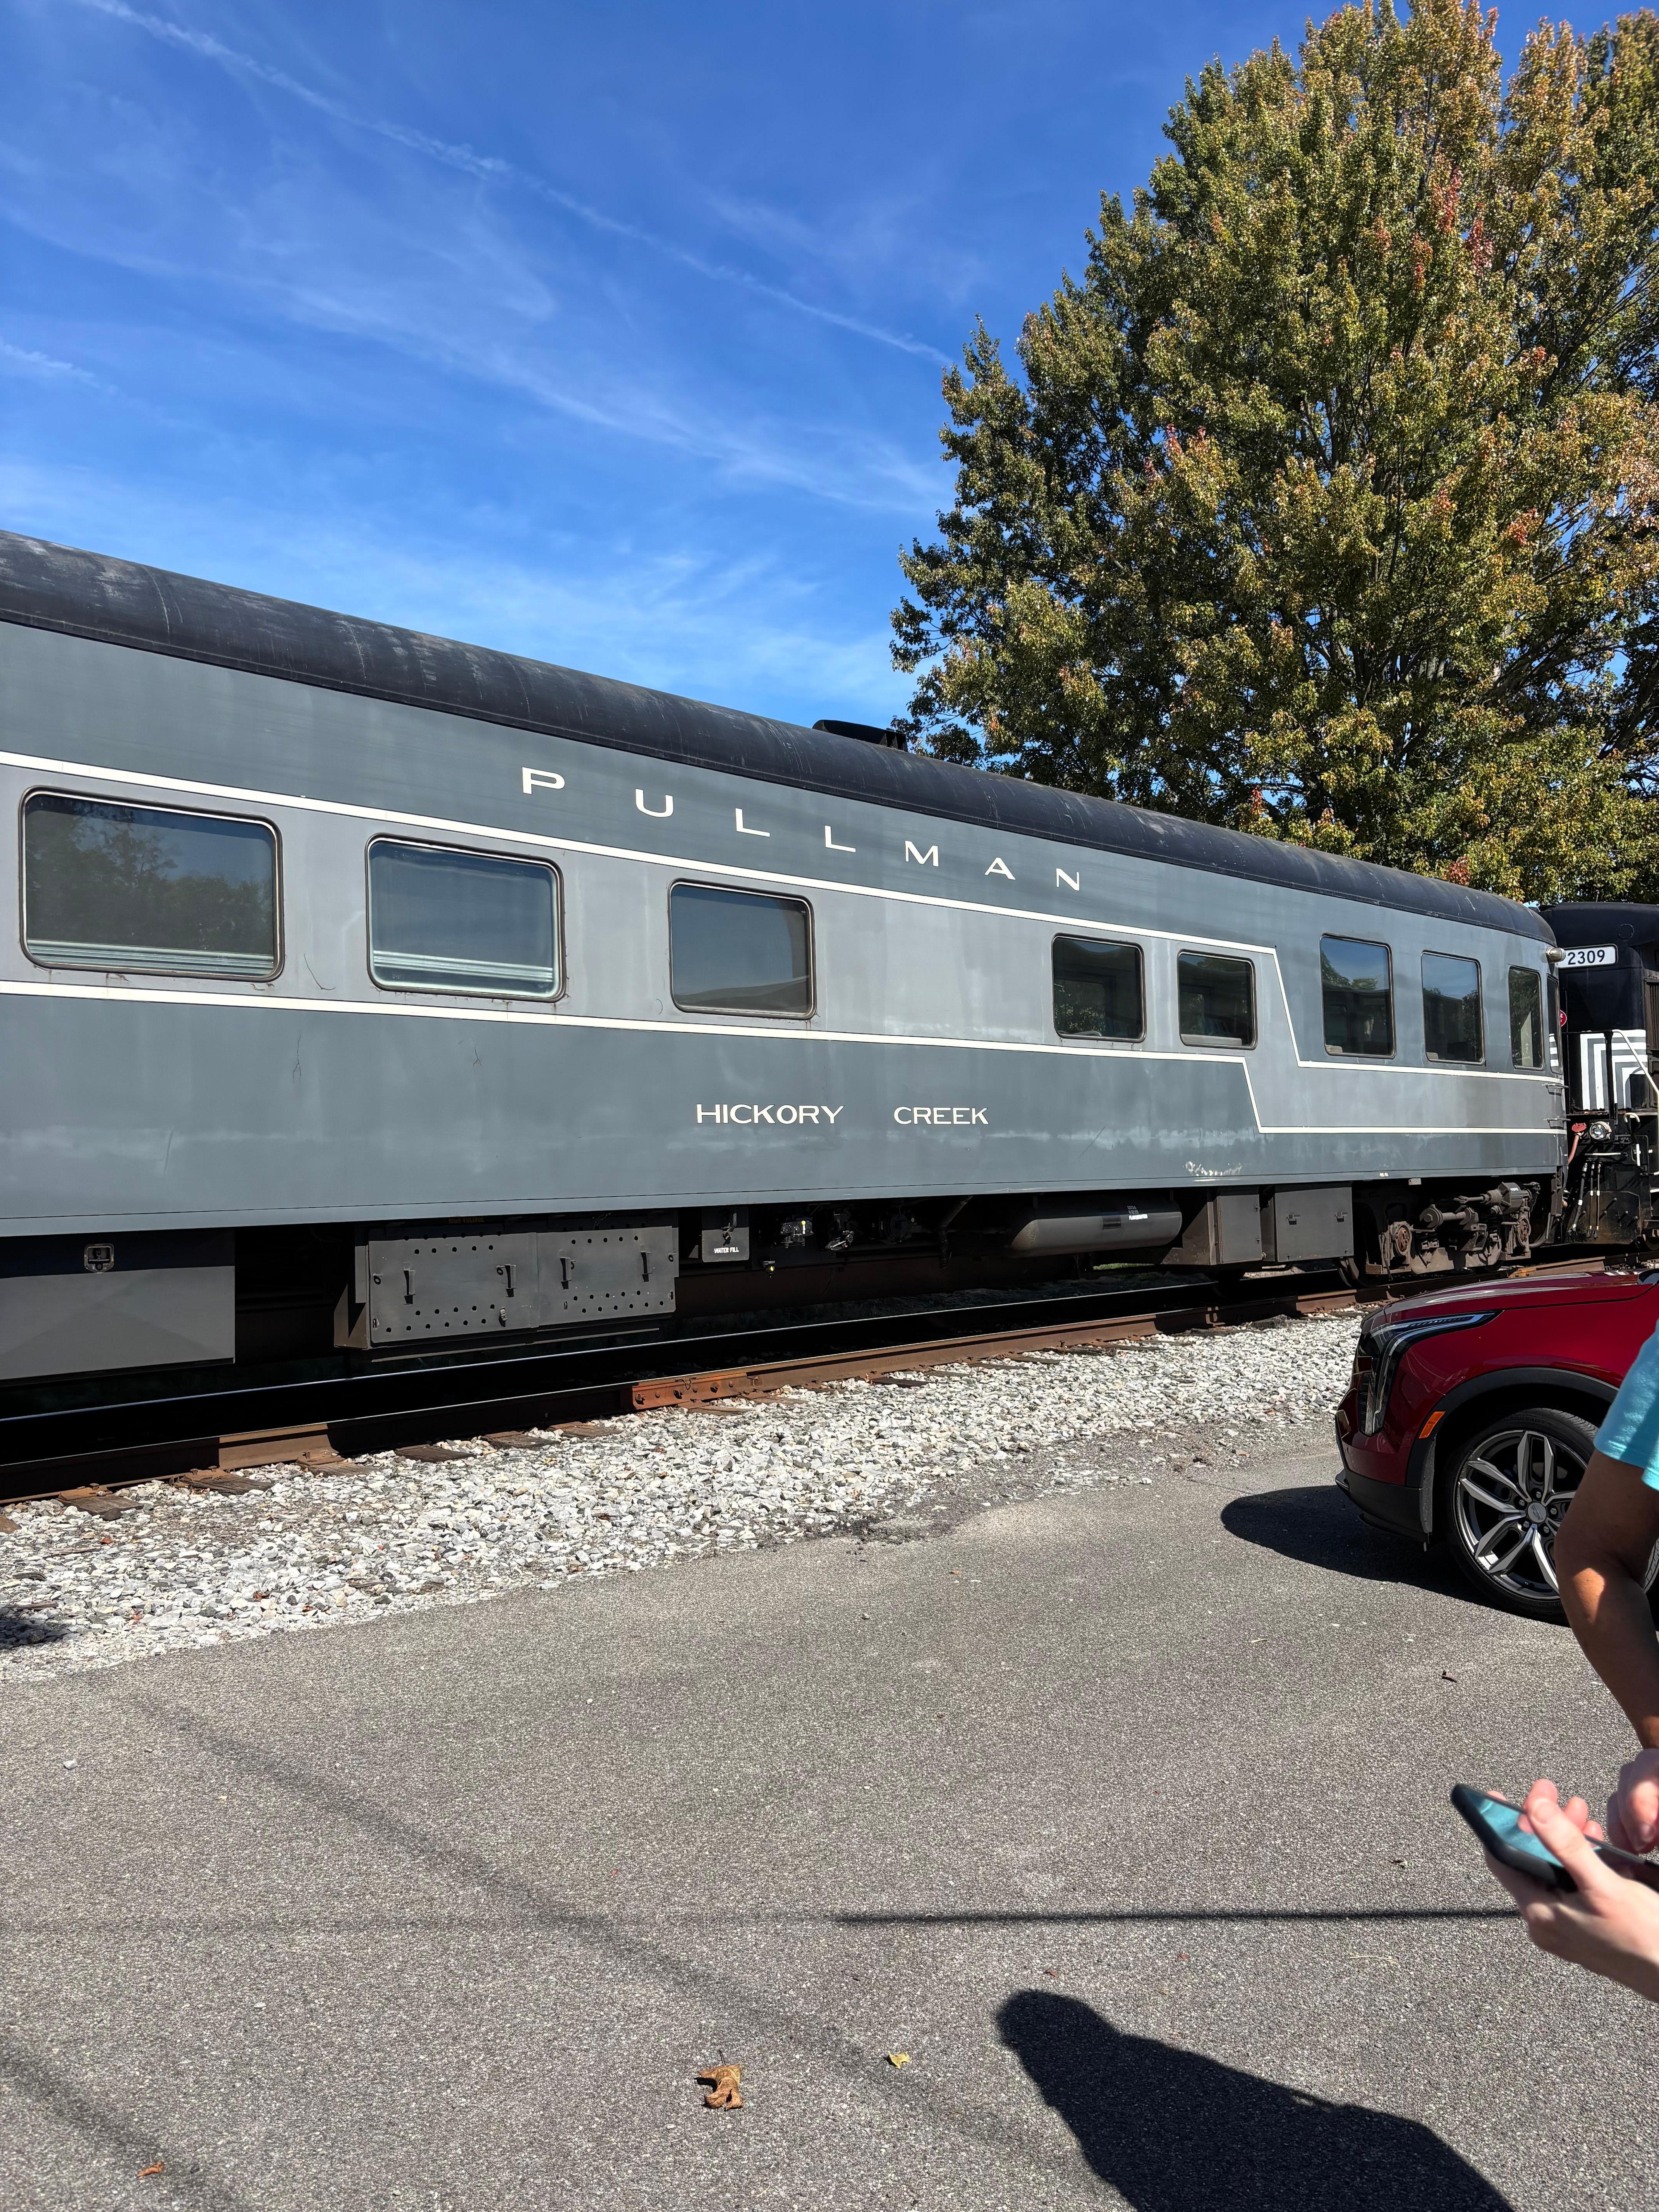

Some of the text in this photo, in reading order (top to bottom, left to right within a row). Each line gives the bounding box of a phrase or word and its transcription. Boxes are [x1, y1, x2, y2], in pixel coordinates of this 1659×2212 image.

[522, 766, 1080, 891] PULLMAN
[1567, 949, 1605, 965] 2309
[696, 1103, 989, 1125] HICKORY CREEK
